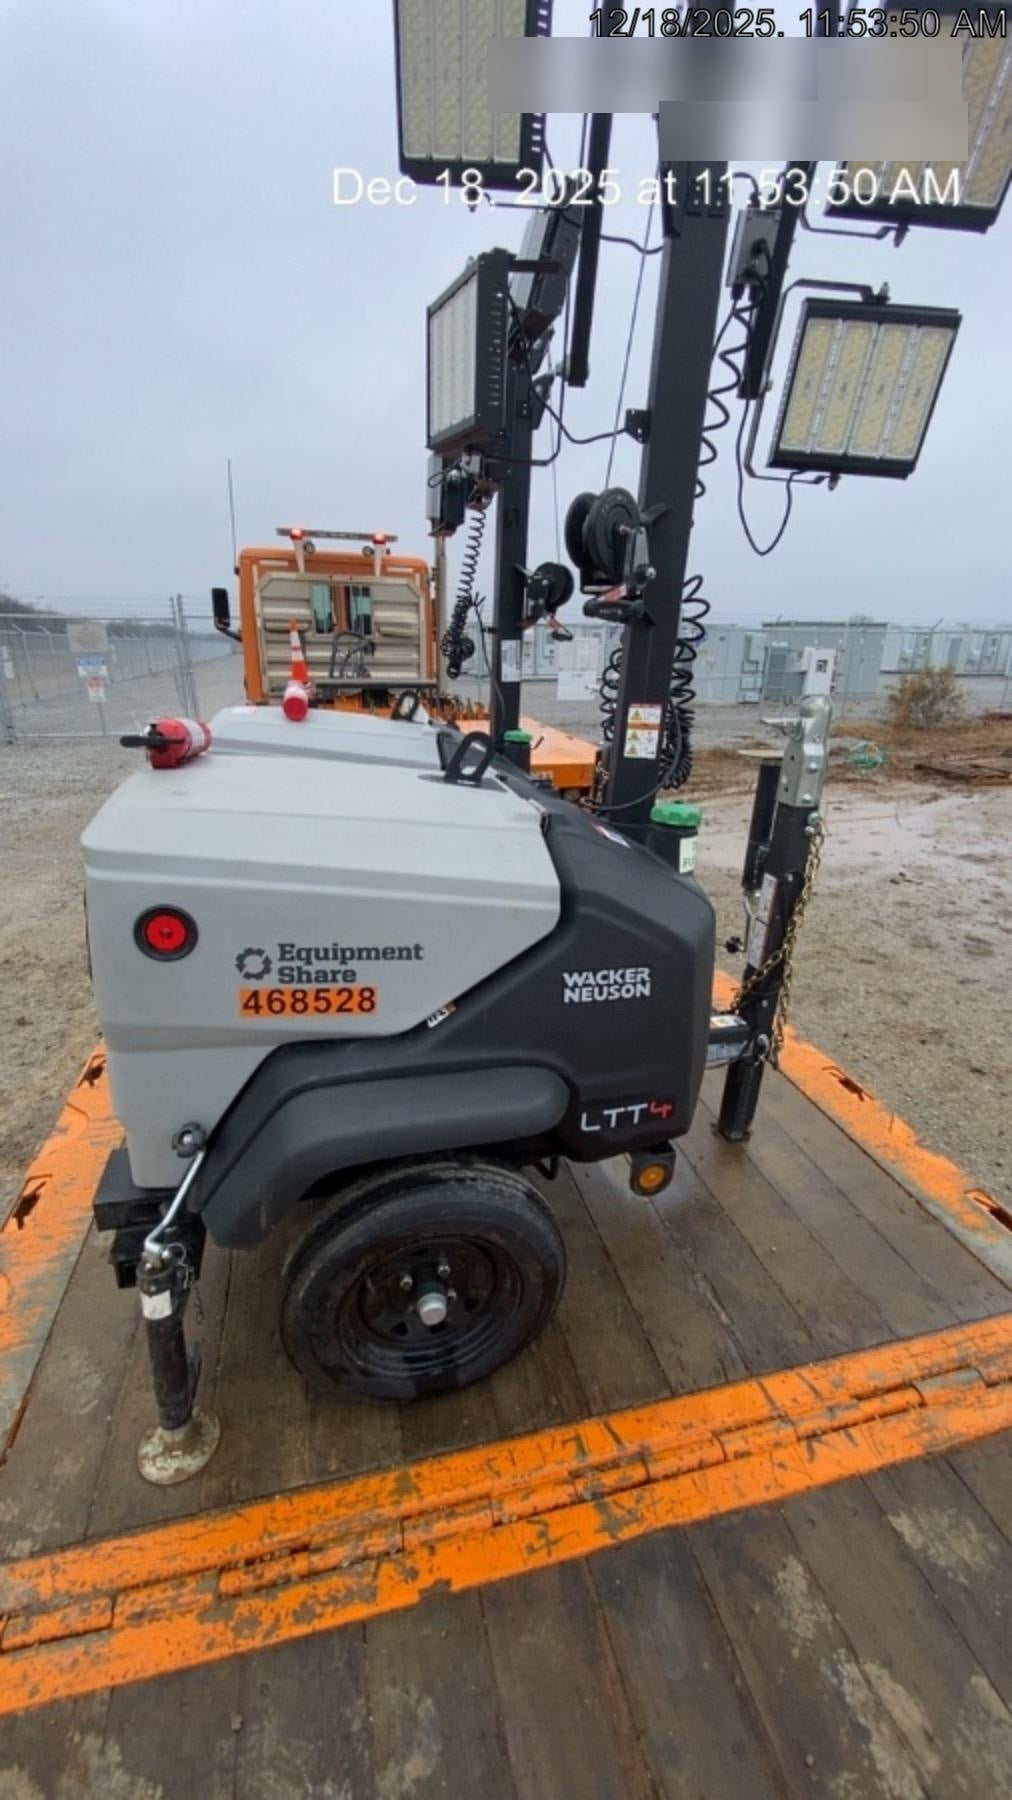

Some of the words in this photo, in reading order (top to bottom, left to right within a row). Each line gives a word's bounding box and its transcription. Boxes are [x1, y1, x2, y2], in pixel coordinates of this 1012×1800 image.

[277, 943, 424, 966] Equipment
[277, 965, 357, 985] Share
[562, 967, 651, 988] WACKER
[242, 987, 376, 1015] 468528
[563, 981, 651, 1003] NEUSON
[581, 1102, 673, 1131] LTT4
